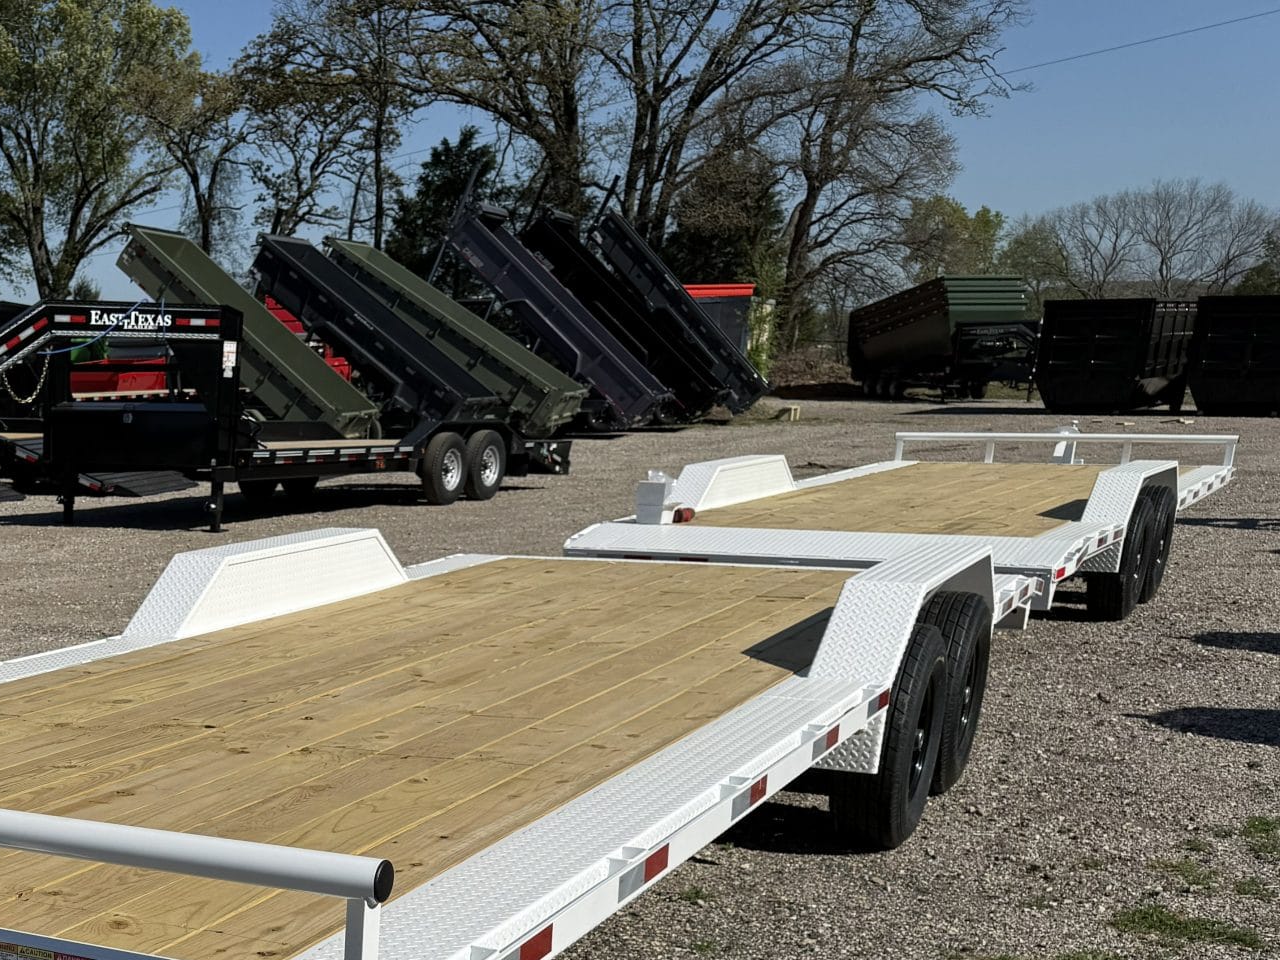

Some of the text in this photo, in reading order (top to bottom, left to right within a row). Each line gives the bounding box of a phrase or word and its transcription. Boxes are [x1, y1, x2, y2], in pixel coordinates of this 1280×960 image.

[90, 310, 172, 327] EAST TEXAS
[26, 947, 53, 959] CAUTION
